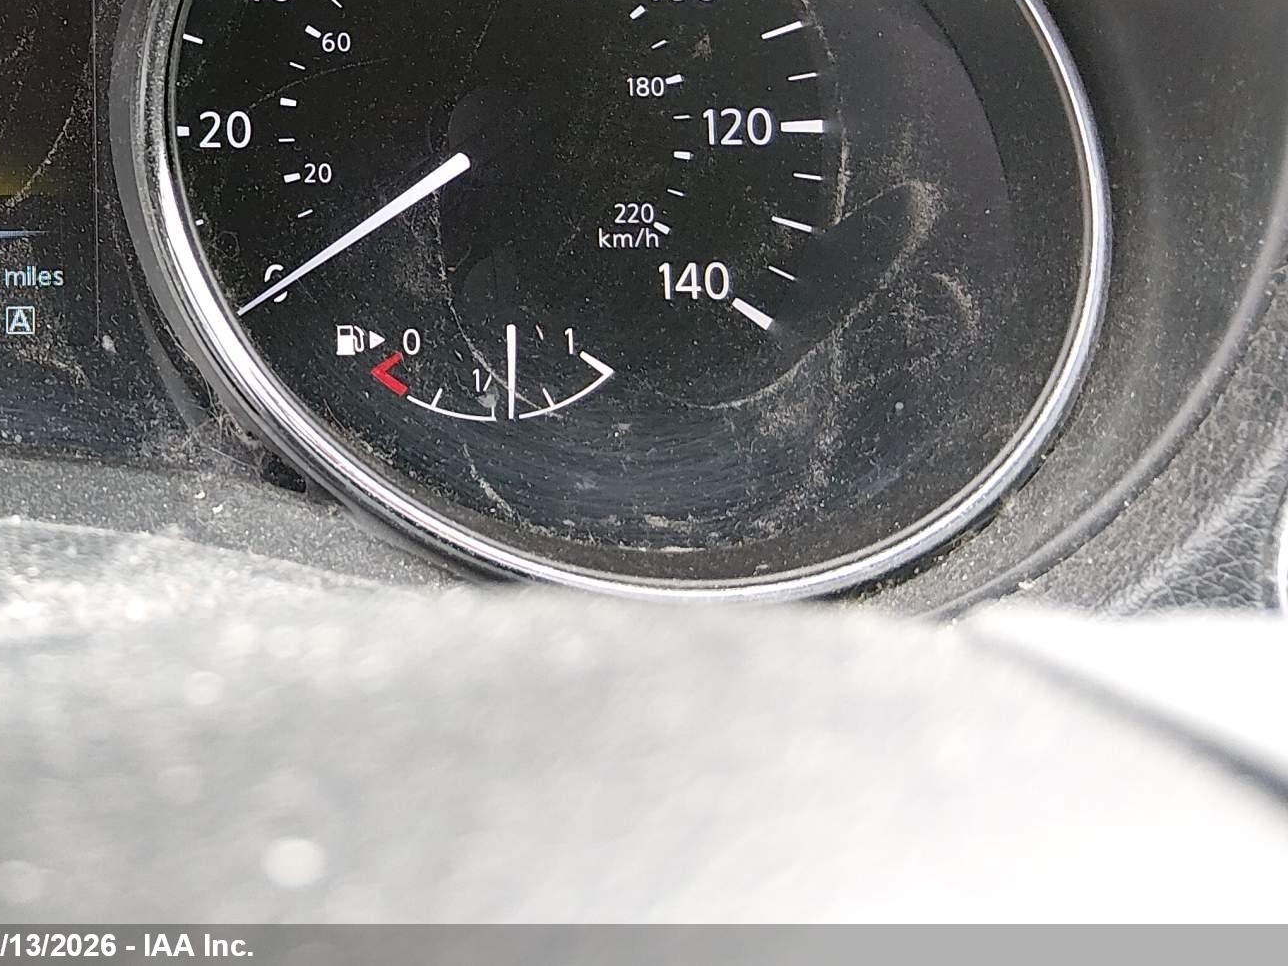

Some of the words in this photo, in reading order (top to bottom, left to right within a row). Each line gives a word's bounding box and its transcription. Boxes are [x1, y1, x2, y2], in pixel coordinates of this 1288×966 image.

[321, 32, 352, 53] 60
[626, 76, 665, 97] 180
[199, 110, 252, 149] 20
[704, 107, 773, 146] 120
[304, 162, 333, 184] 20
[613, 202, 655, 224] 220
[598, 227, 660, 249] km/h
[4, 265, 65, 289] miles
[658, 261, 730, 300] 140
[9, 309, 32, 333] A
[402, 328, 422, 356] 0
[563, 327, 576, 355] 1
